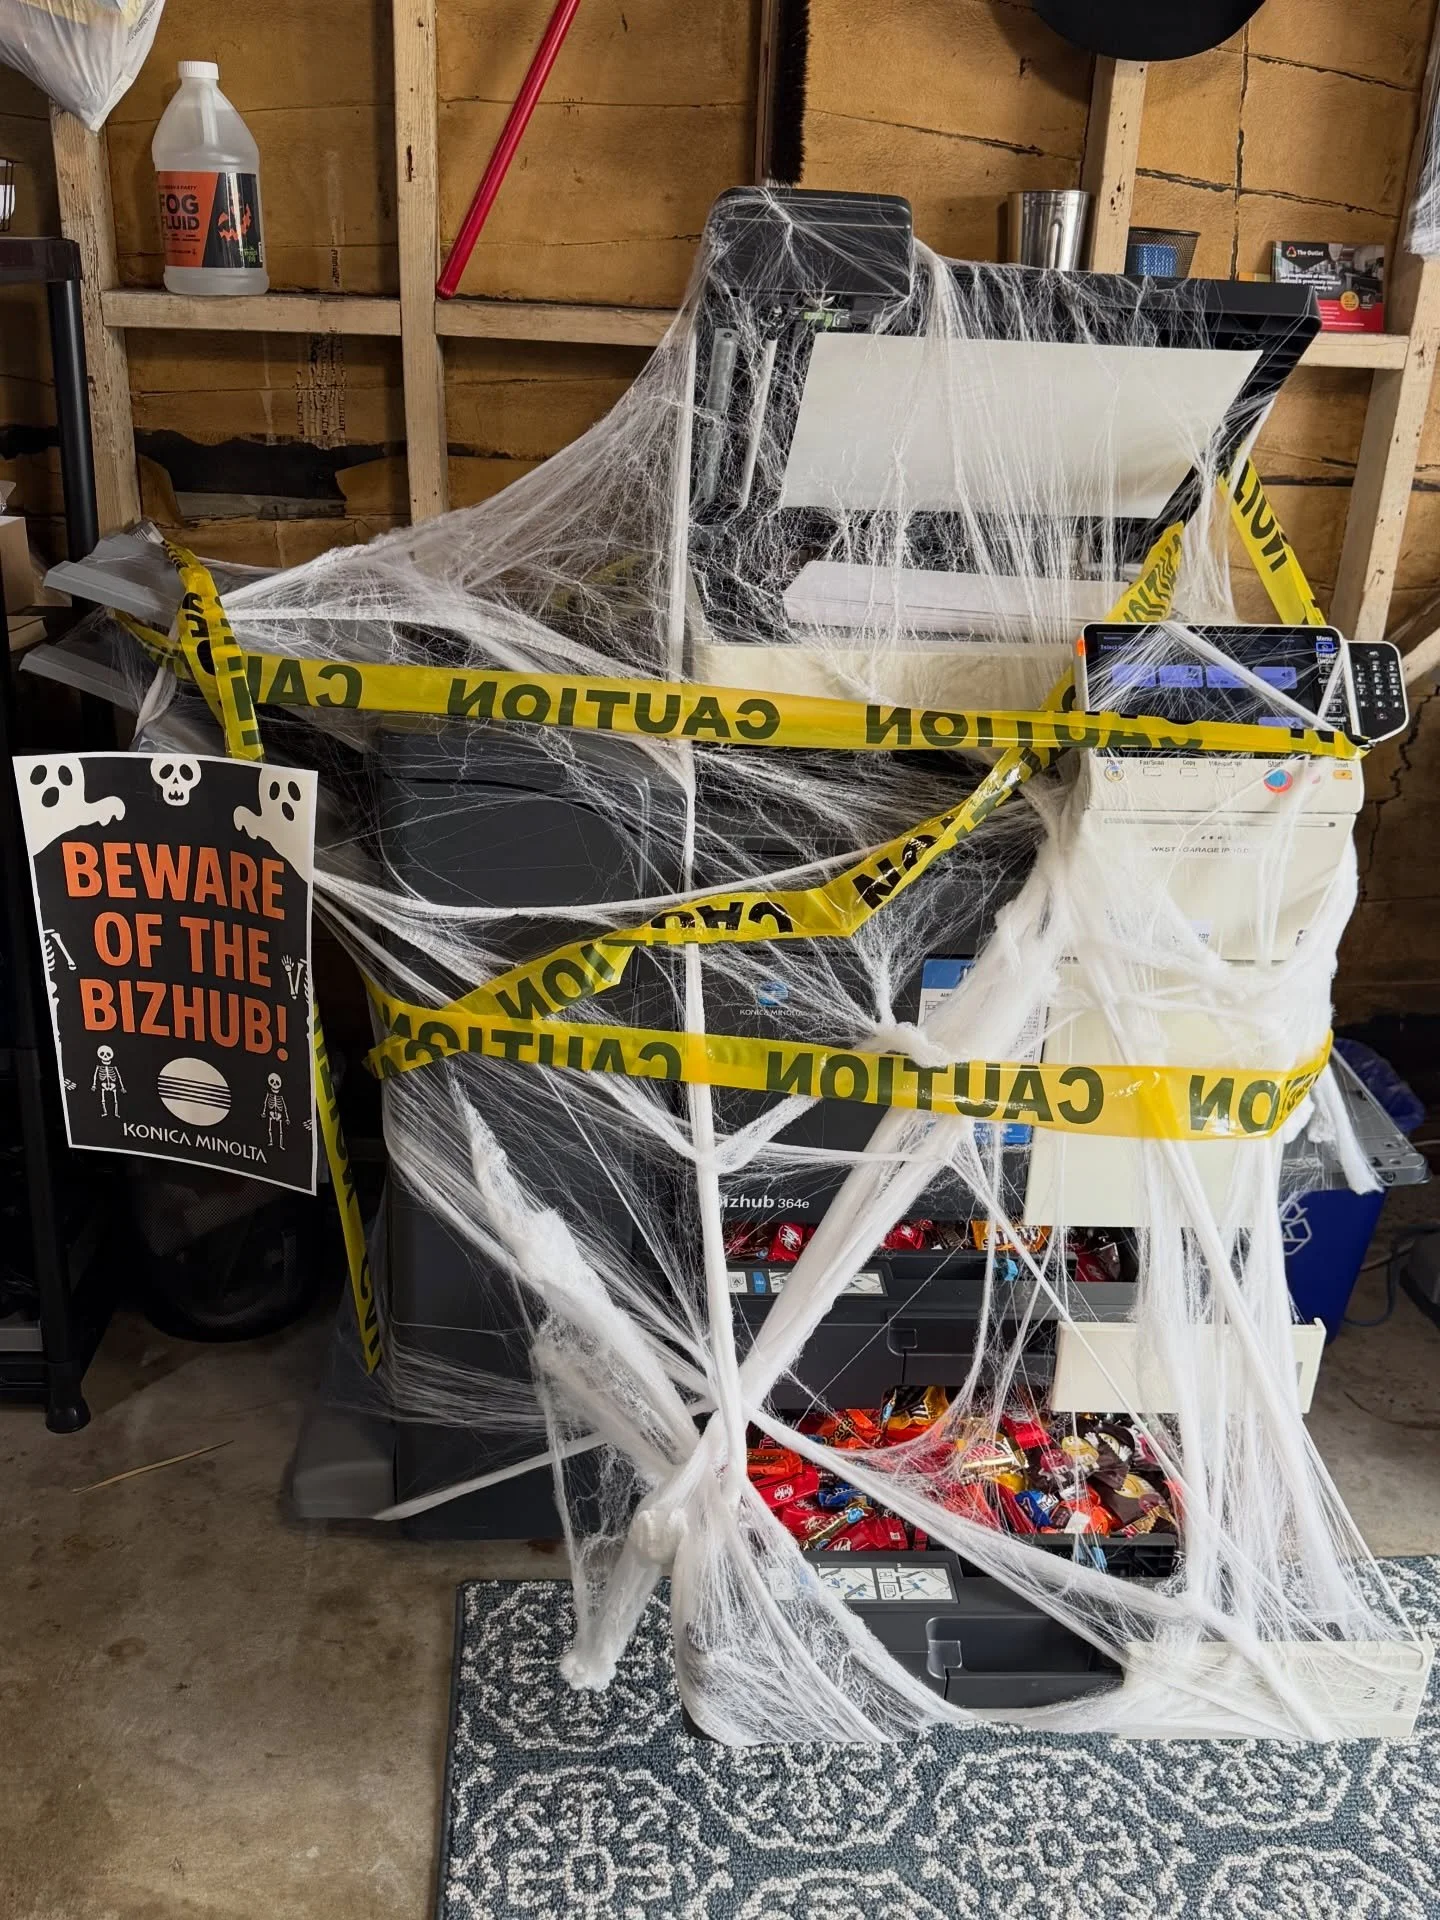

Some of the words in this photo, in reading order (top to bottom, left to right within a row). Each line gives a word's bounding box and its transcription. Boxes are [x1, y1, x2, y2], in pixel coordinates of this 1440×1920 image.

[159, 193, 200, 215] FOG
[161, 216, 200, 230] FLUID
[61, 841, 286, 921] BEWARE
[93, 911, 163, 969] OF
[180, 915, 272, 988] THE
[80, 977, 290, 1063] BIZHUB!
[123, 1122, 192, 1148] KONICA
[196, 1134, 267, 1164] MINOLTA
[777, 1198, 810, 1209] 364e
